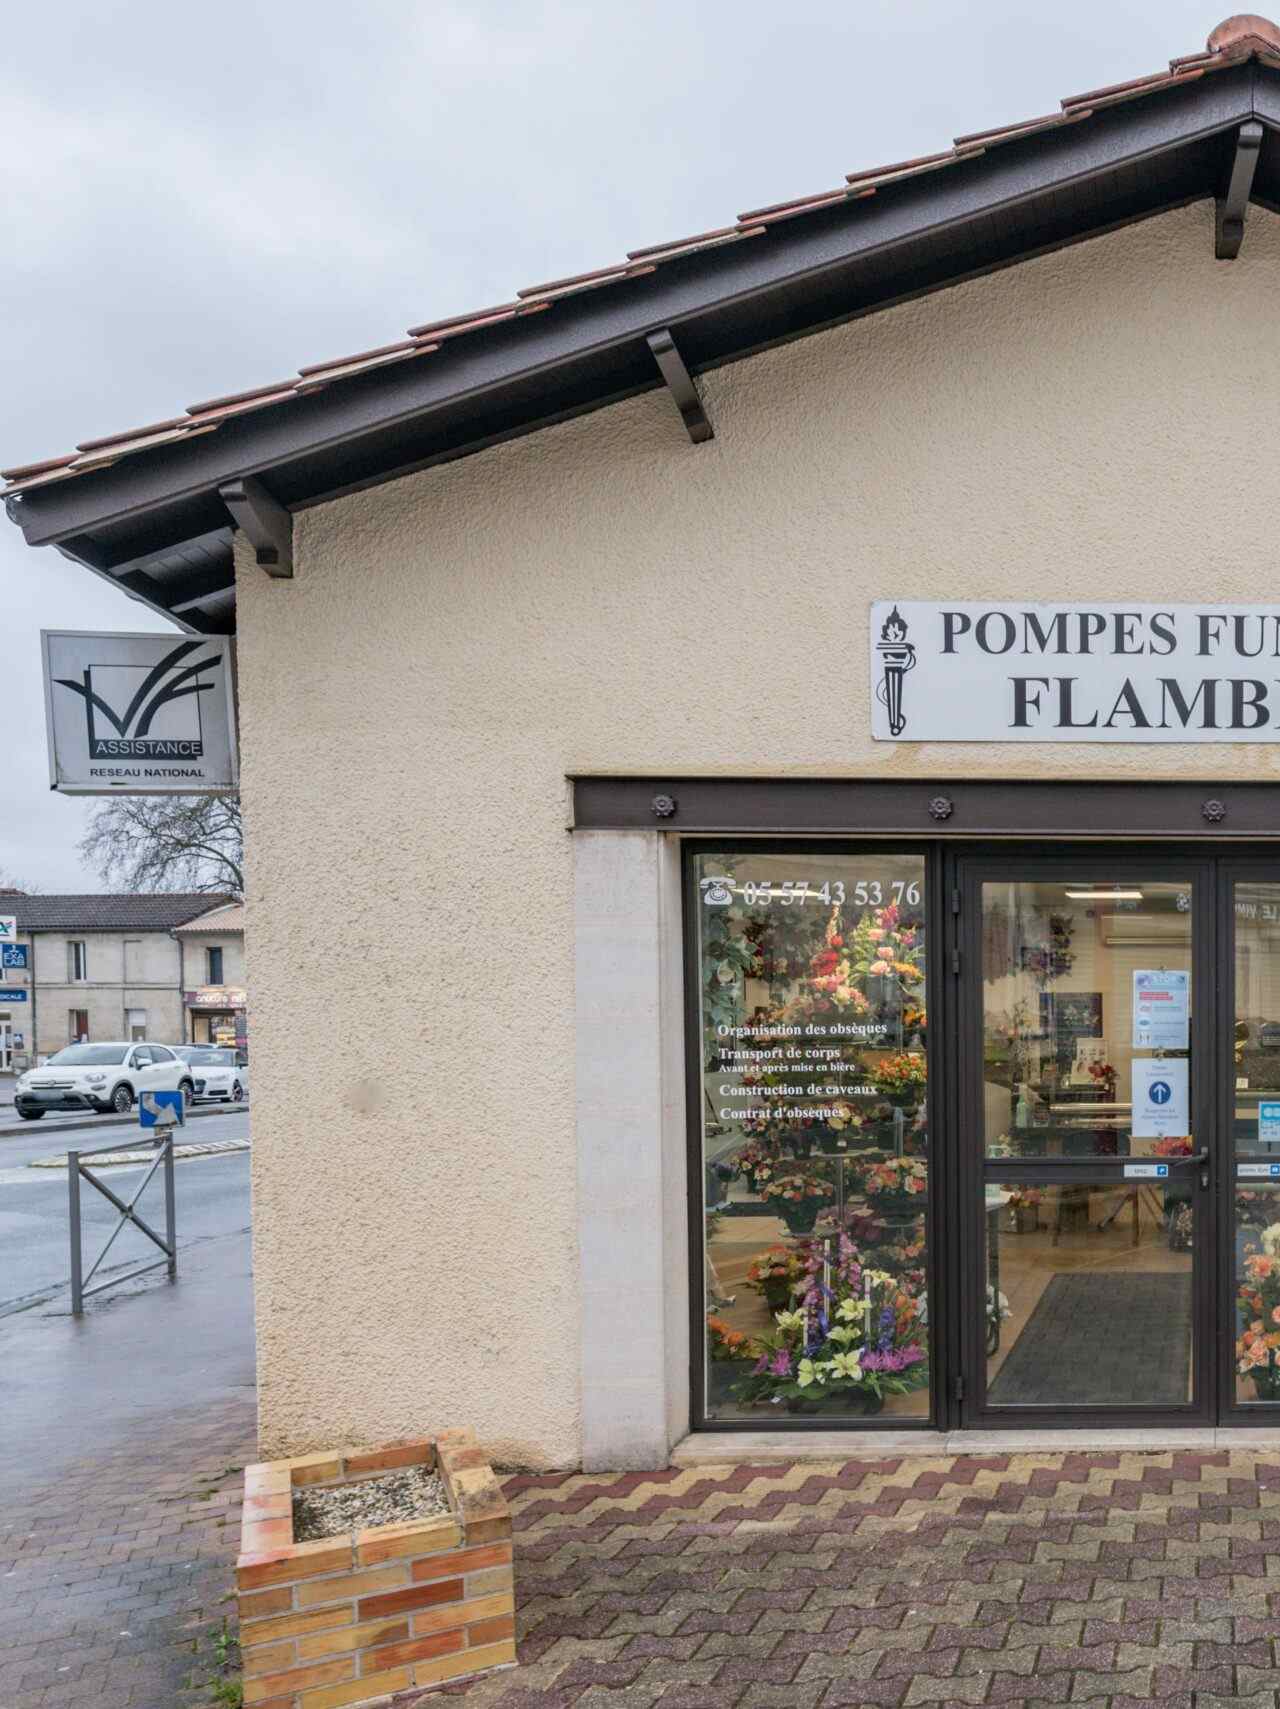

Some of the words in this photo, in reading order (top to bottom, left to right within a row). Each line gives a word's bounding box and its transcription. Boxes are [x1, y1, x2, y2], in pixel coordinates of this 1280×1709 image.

[938, 611, 1178, 656] POMPES
[96, 741, 202, 755] ASSISTANCE
[90, 768, 141, 777] RESEAU
[144, 768, 205, 777] NATIONAL
[744, 881, 772, 906] 05
[780, 881, 809, 906] 57
[818, 881, 846, 906] 43
[855, 881, 882, 906] 53
[891, 881, 920, 906] 76
[717, 1024, 802, 1037] Organisation
[805, 1024, 826, 1035] des
[830, 1022, 888, 1035] obsèques
[718, 1047, 783, 1060] Transport
[787, 1047, 802, 1058] de
[805, 1049, 840, 1060] corps
[719, 1064, 748, 1073] Avant
[751, 1064, 760, 1072] et
[762, 1063, 789, 1075] après
[791, 1063, 814, 1072] mise
[830, 1062, 855, 1072] bière
[719, 1084, 804, 1096] Construction
[807, 1084, 823, 1095] de
[825, 1085, 878, 1095] caveaux
[720, 1107, 771, 1120] Contrat
